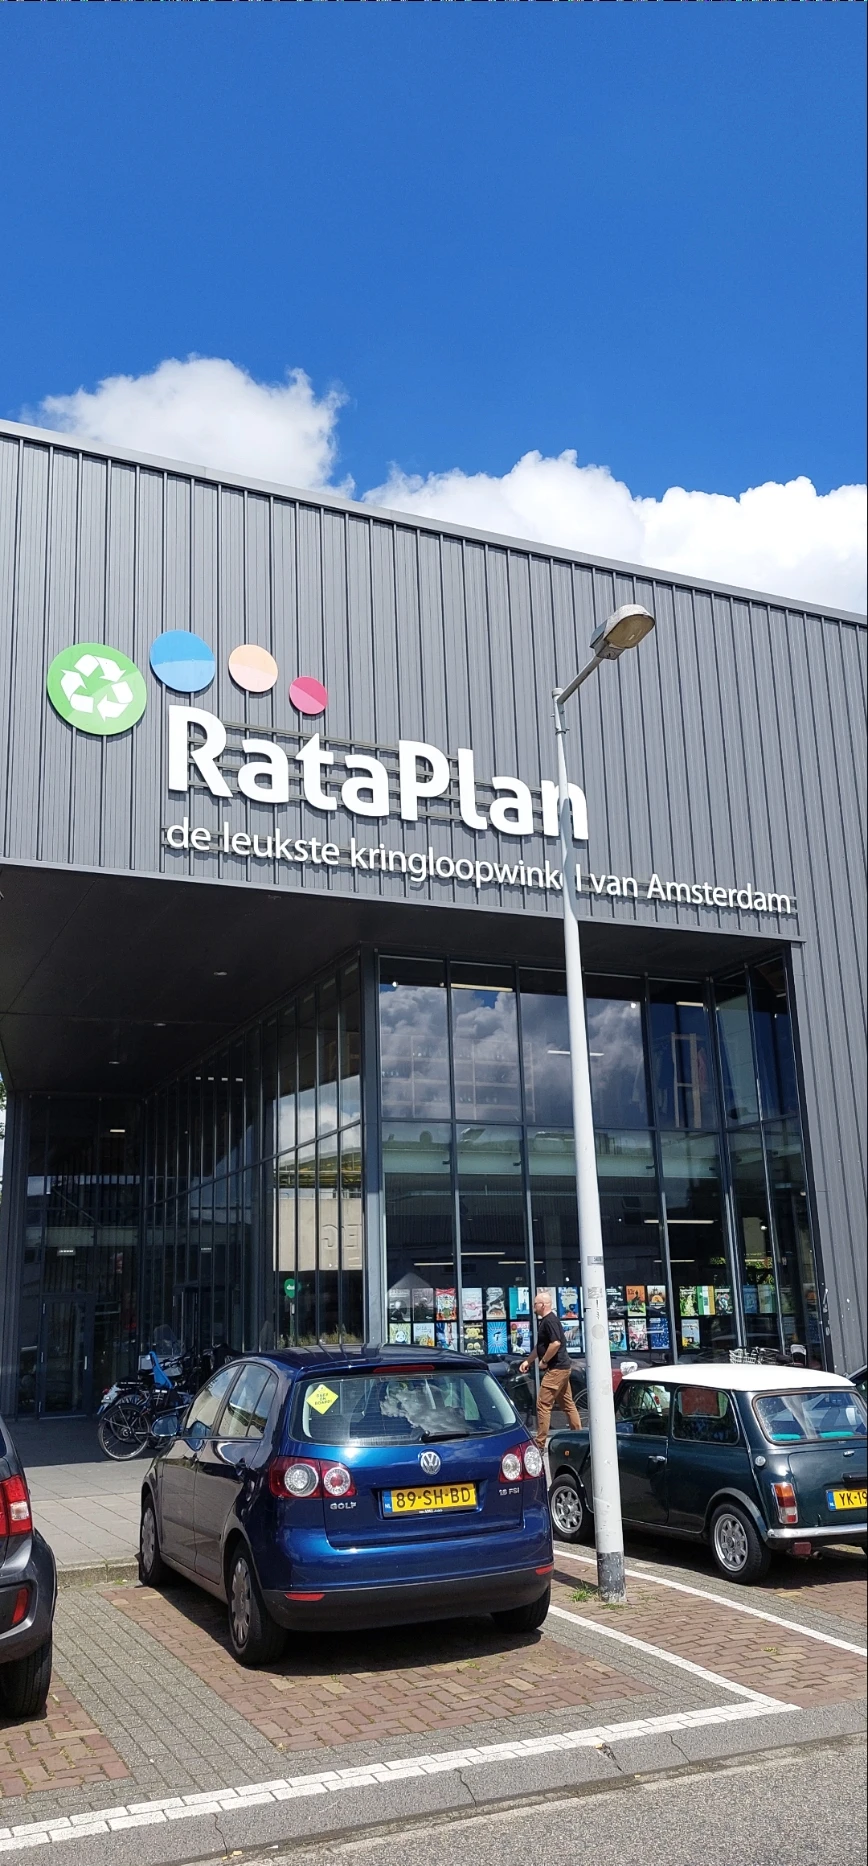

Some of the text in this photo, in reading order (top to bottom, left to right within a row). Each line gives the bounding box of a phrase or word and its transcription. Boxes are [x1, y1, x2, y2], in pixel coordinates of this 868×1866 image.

[168, 704, 589, 840] RataPlan
[166, 816, 792, 915] de leukste kringloopwinkl van Amsterdam
[330, 1501, 357, 1510] GOLF
[396, 1486, 471, 1509] 89-SH-BD
